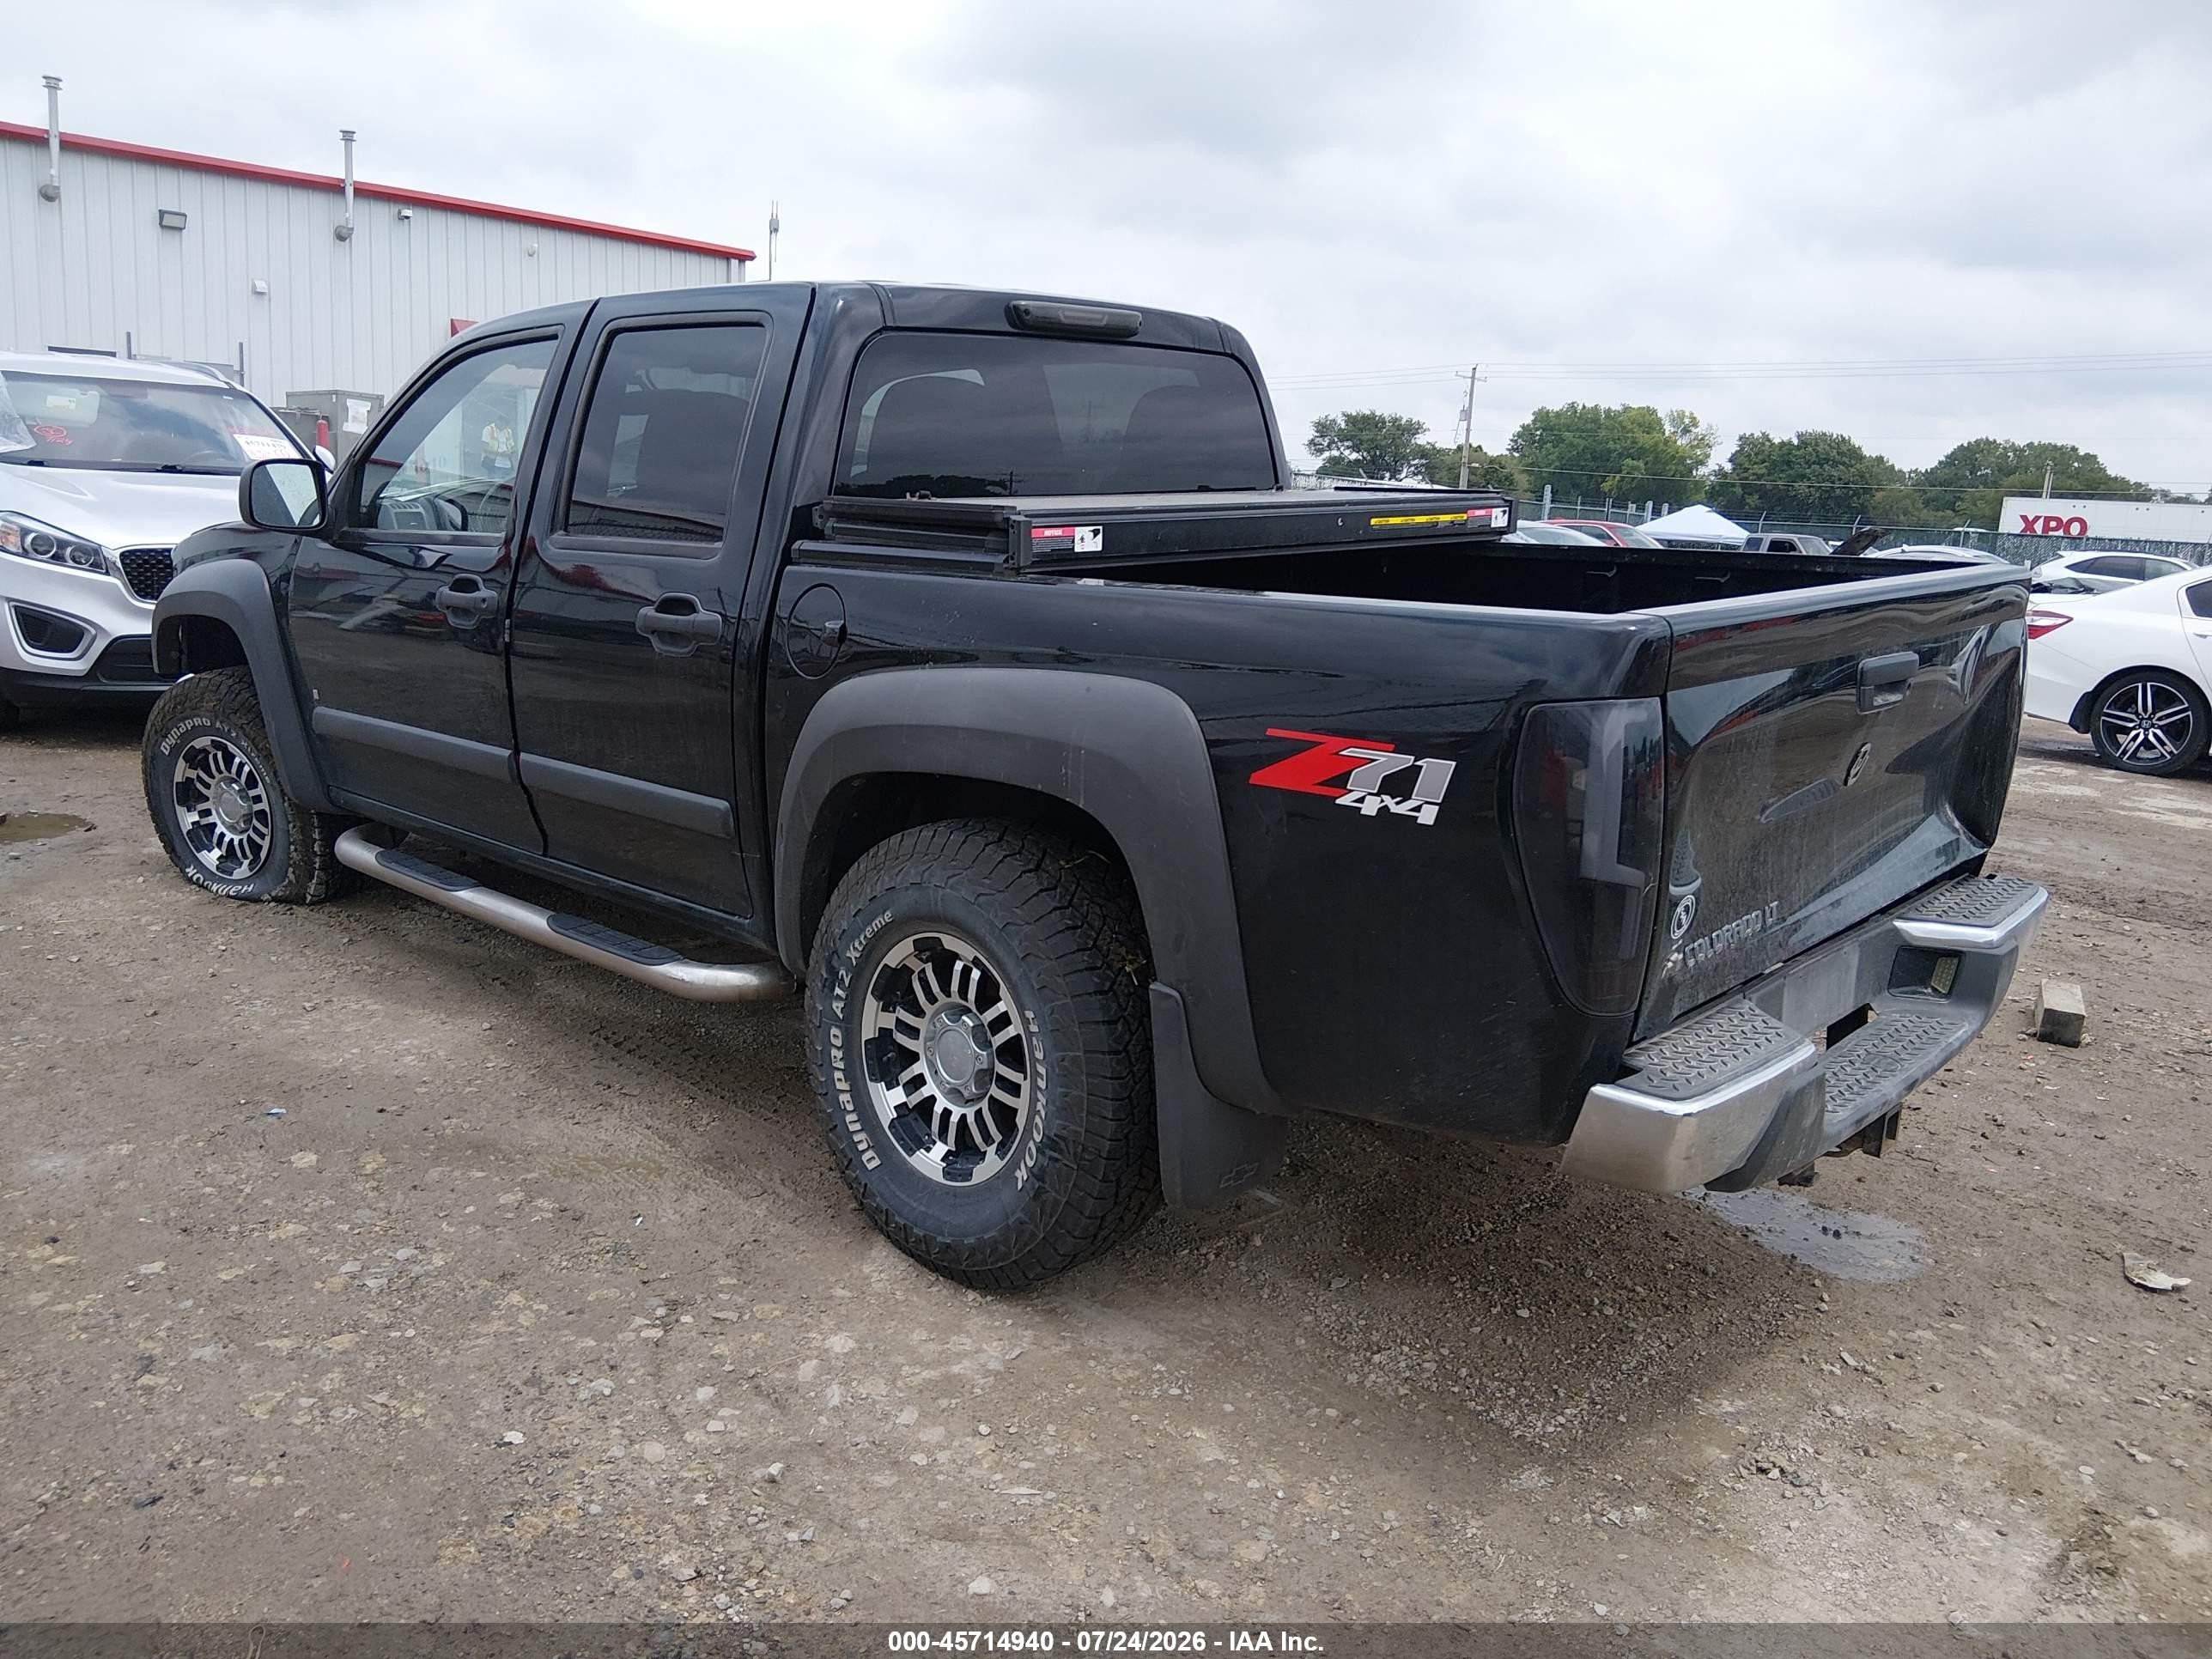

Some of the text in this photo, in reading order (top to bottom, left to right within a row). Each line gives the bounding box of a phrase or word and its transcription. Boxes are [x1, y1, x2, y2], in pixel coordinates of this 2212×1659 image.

[2020, 514, 2088, 537] XPO
[1249, 727, 1457, 804] Z71
[830, 968, 854, 1020] AT2
[845, 908, 895, 967] Xtreme
